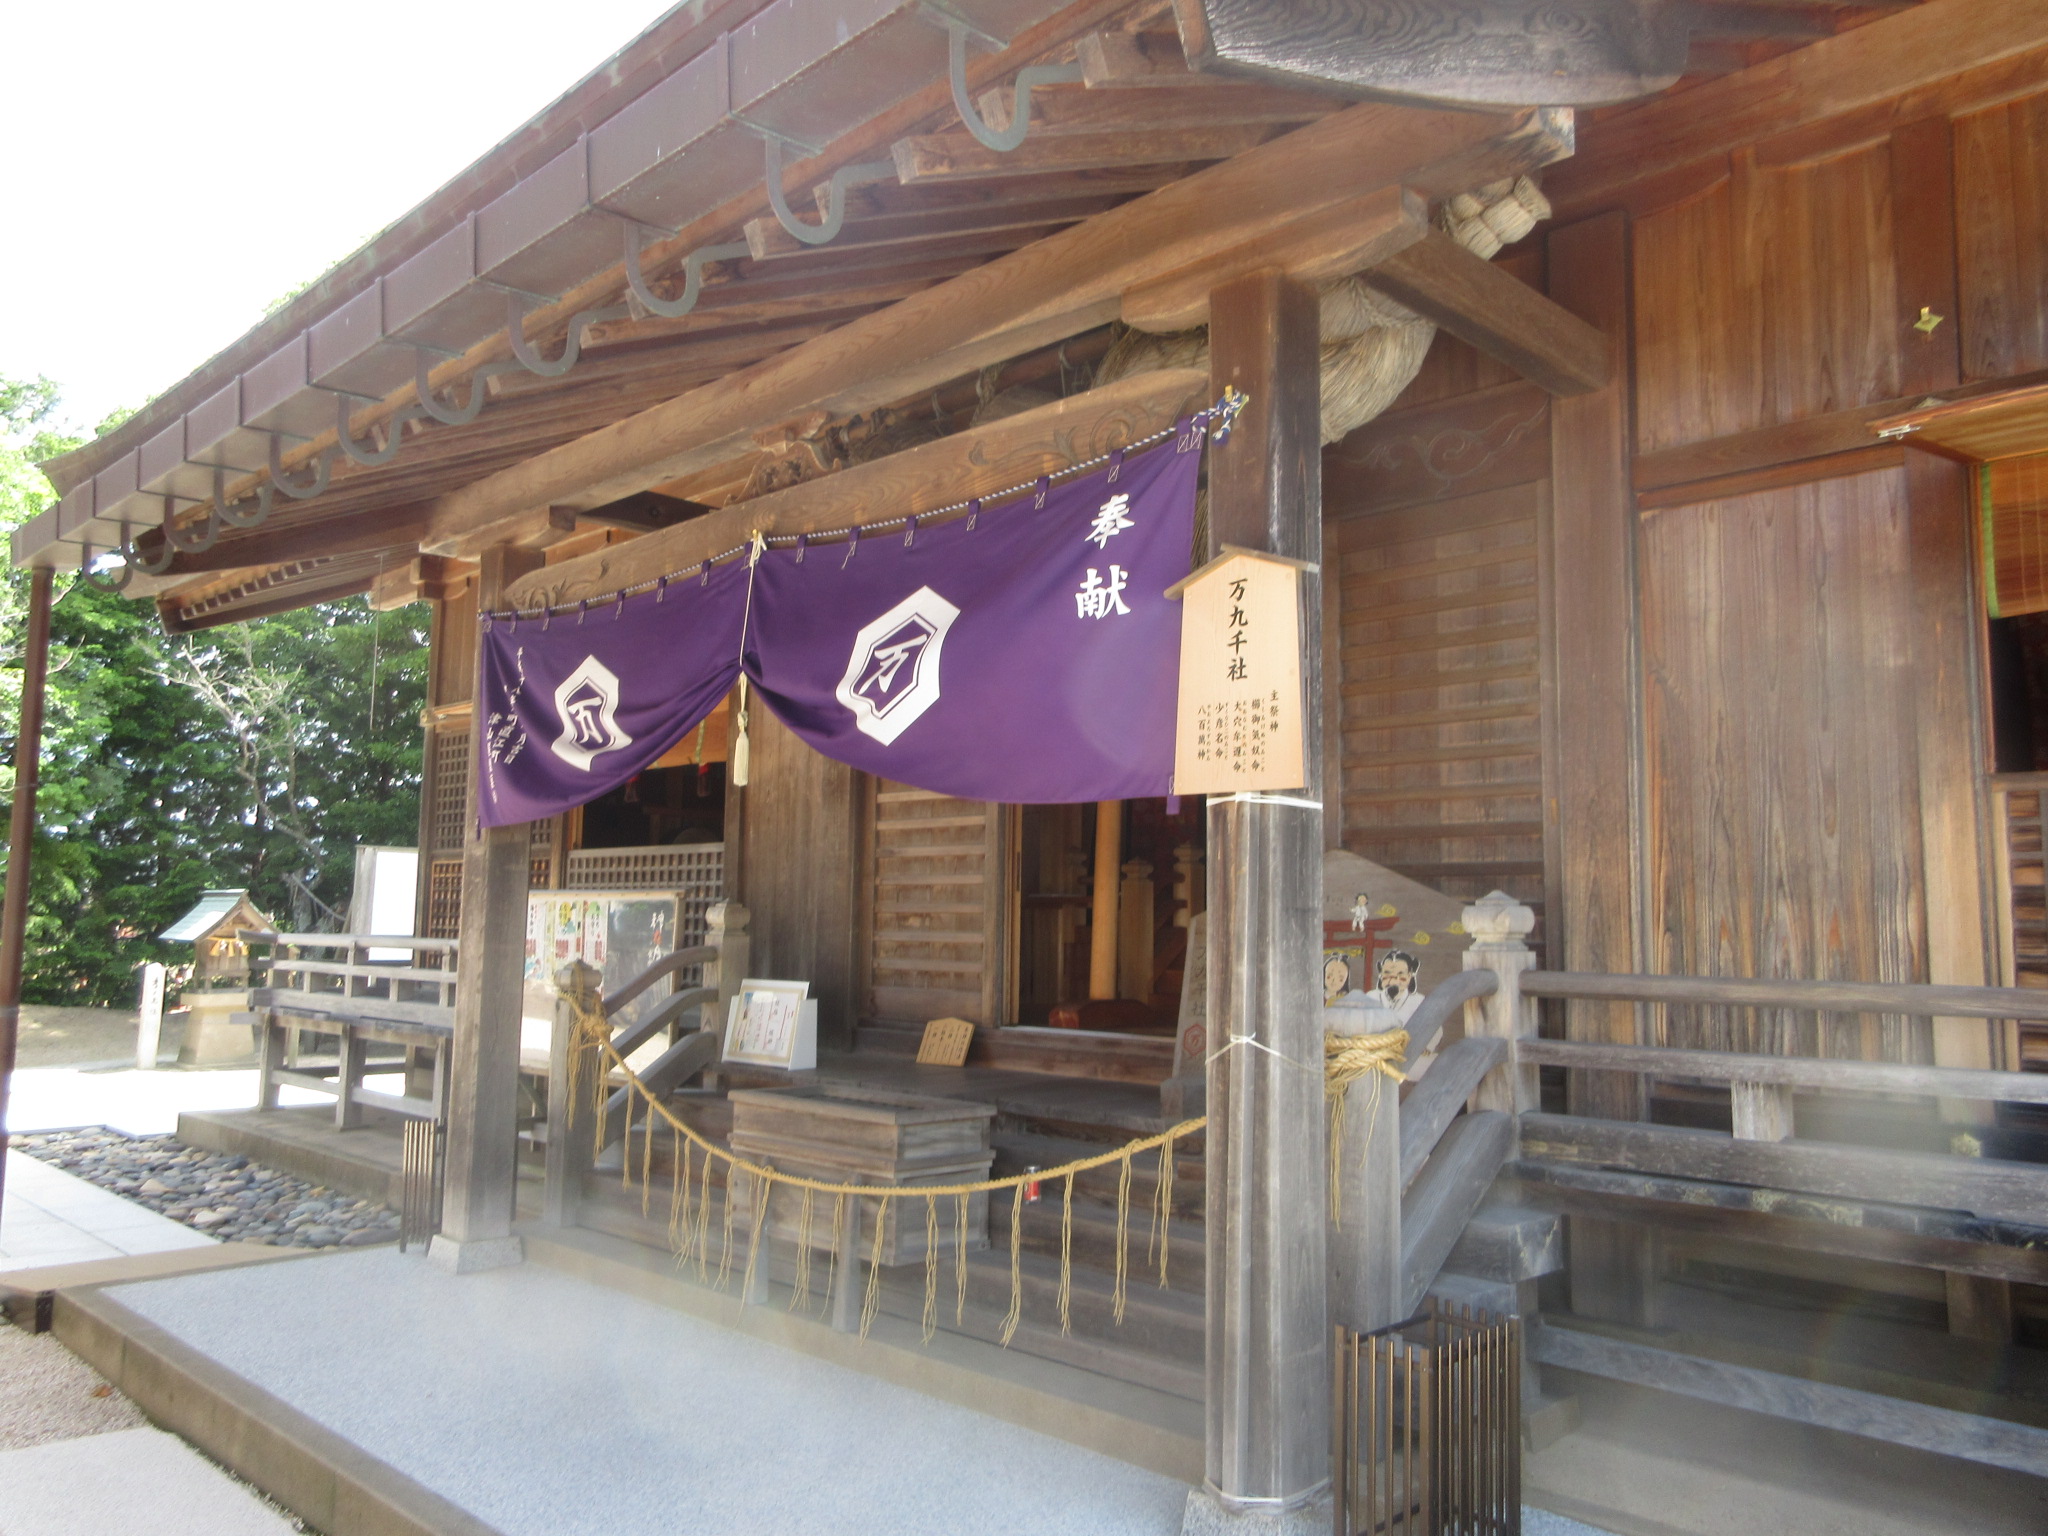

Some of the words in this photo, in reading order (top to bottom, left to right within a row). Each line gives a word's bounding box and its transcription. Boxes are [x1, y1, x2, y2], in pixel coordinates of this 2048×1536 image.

[1075, 493, 1136, 621] 奉献
[1226, 578, 1249, 681] 万九千社
[1269, 689, 1279, 733] 主祭神
